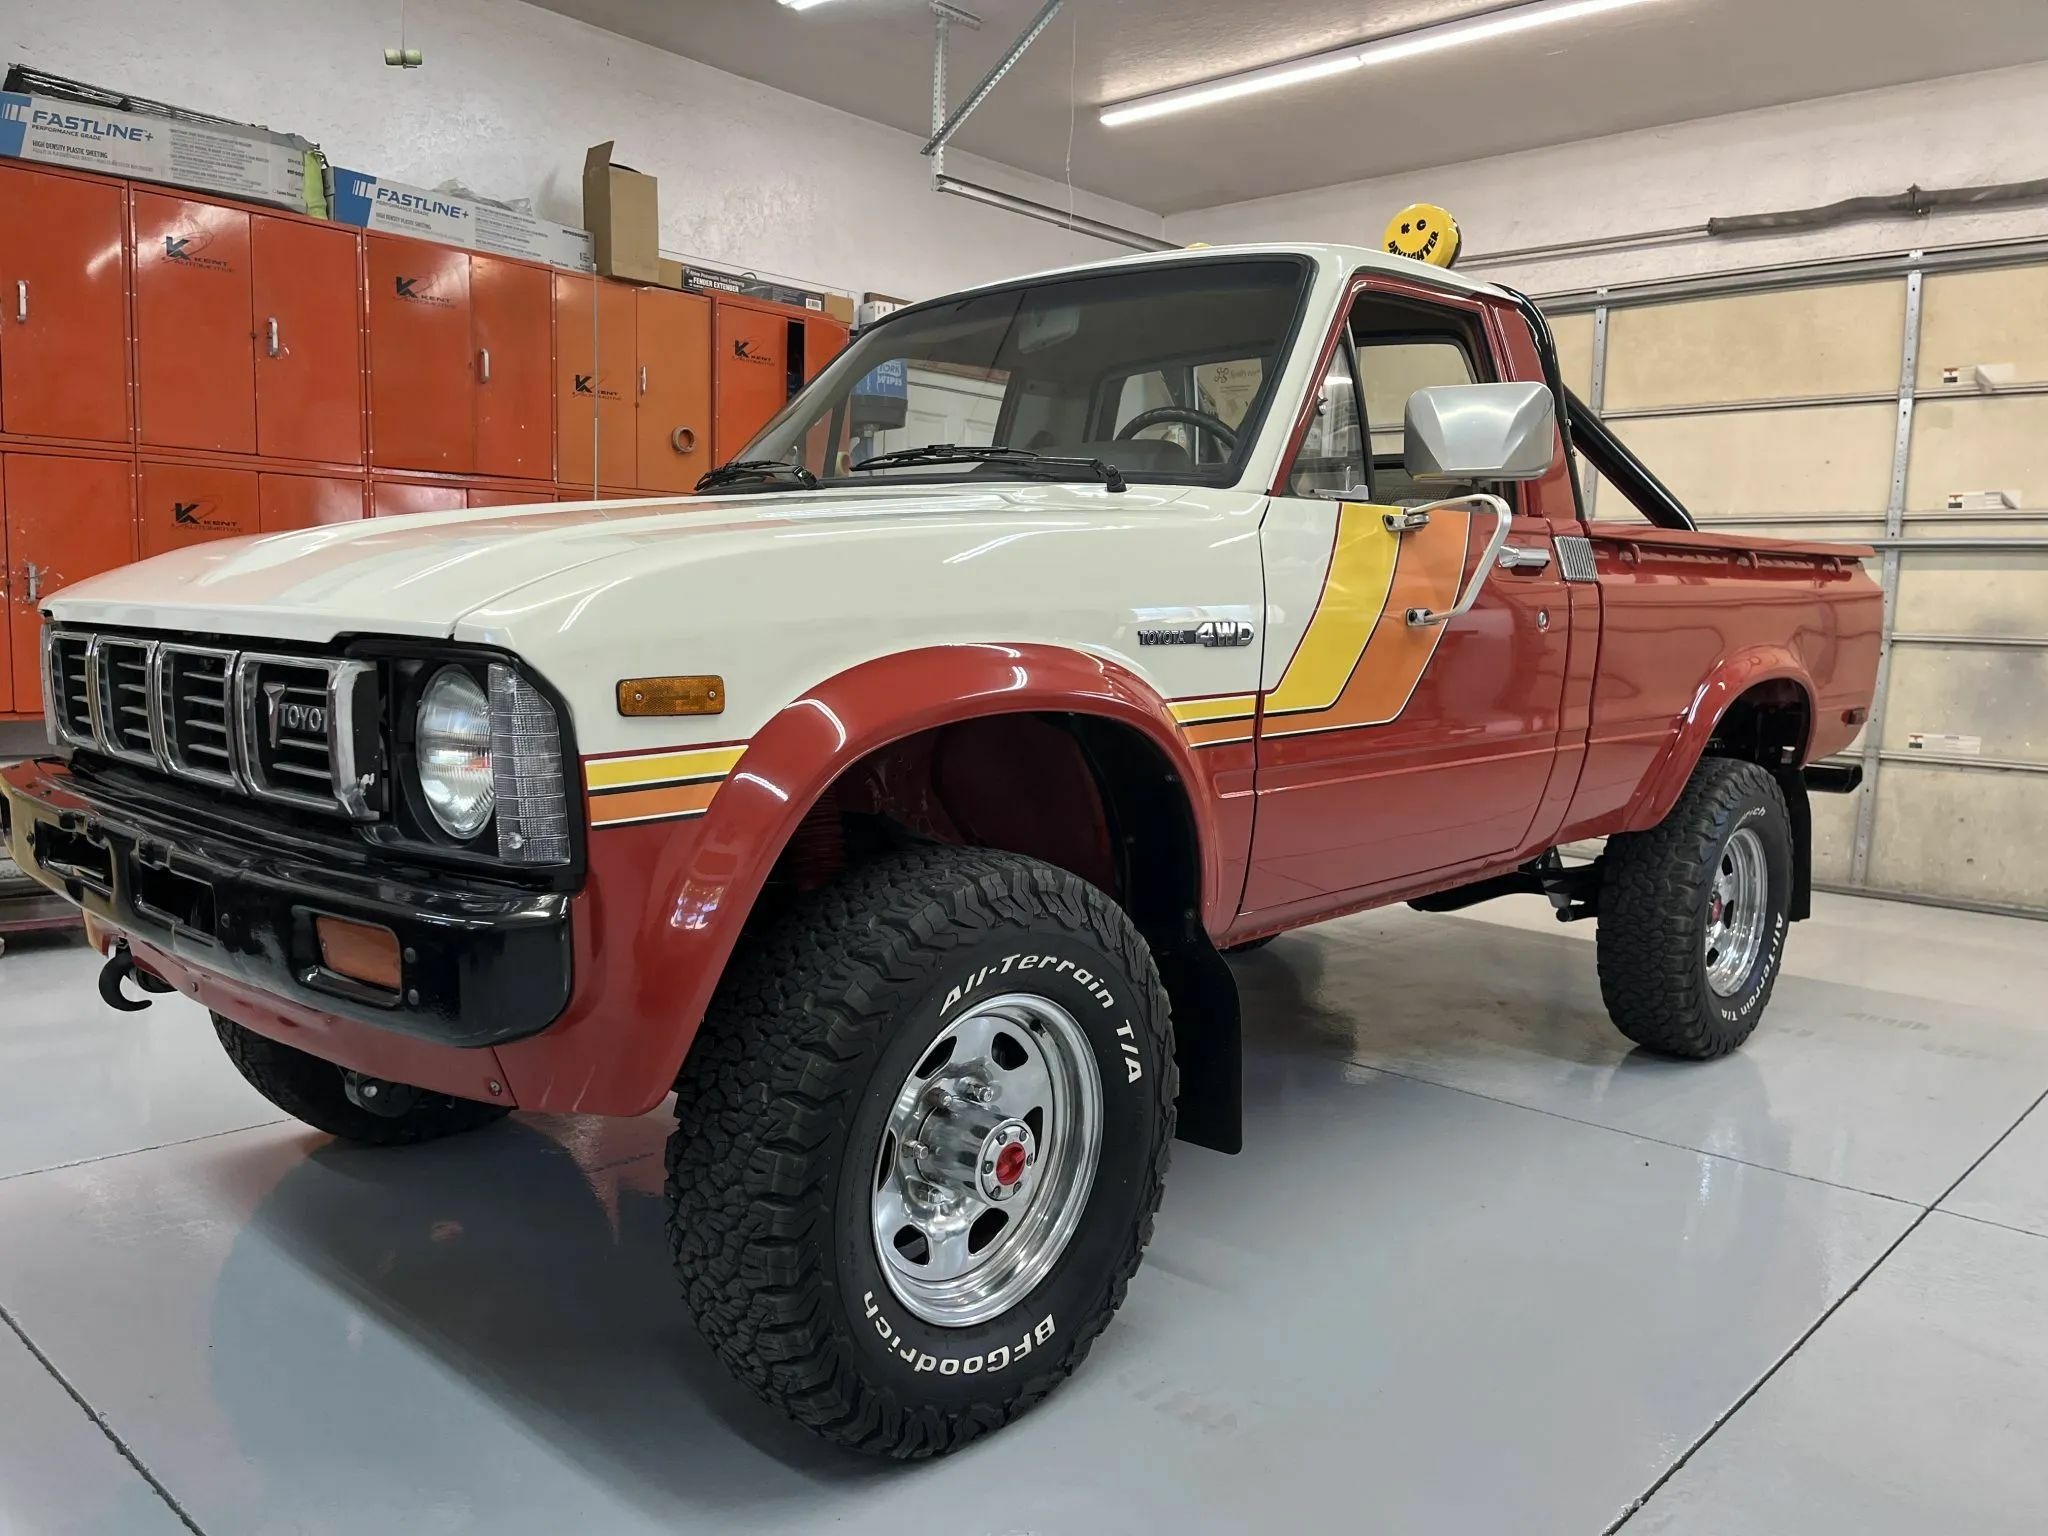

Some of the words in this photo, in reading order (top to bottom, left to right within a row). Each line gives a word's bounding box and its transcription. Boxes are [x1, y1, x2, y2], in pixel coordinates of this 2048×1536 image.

[31, 124, 79, 137] PERFORMANCE
[80, 132, 102, 141] GRADE
[32, 110, 154, 142] FASTLINE+
[32, 140, 45, 149] HIGH
[45, 142, 66, 152] DENSITY
[66, 145, 85, 156] PLASTIC
[85, 148, 108, 159] SHEETING
[376, 187, 469, 219] FASTLINE+
[693, 276, 713, 288] FENDER
[713, 281, 739, 293] EXTENDER
[1139, 630, 1186, 645] TOYOTA
[1196, 621, 1255, 646] 4WD
[279, 704, 328, 733] TOYOT
[1740, 911, 1784, 1016] All-Terrain
[939, 953, 1115, 1017] All-Terrain
[1115, 1019, 1143, 1084] T/A
[863, 1290, 1056, 1376] BFGoodrich
